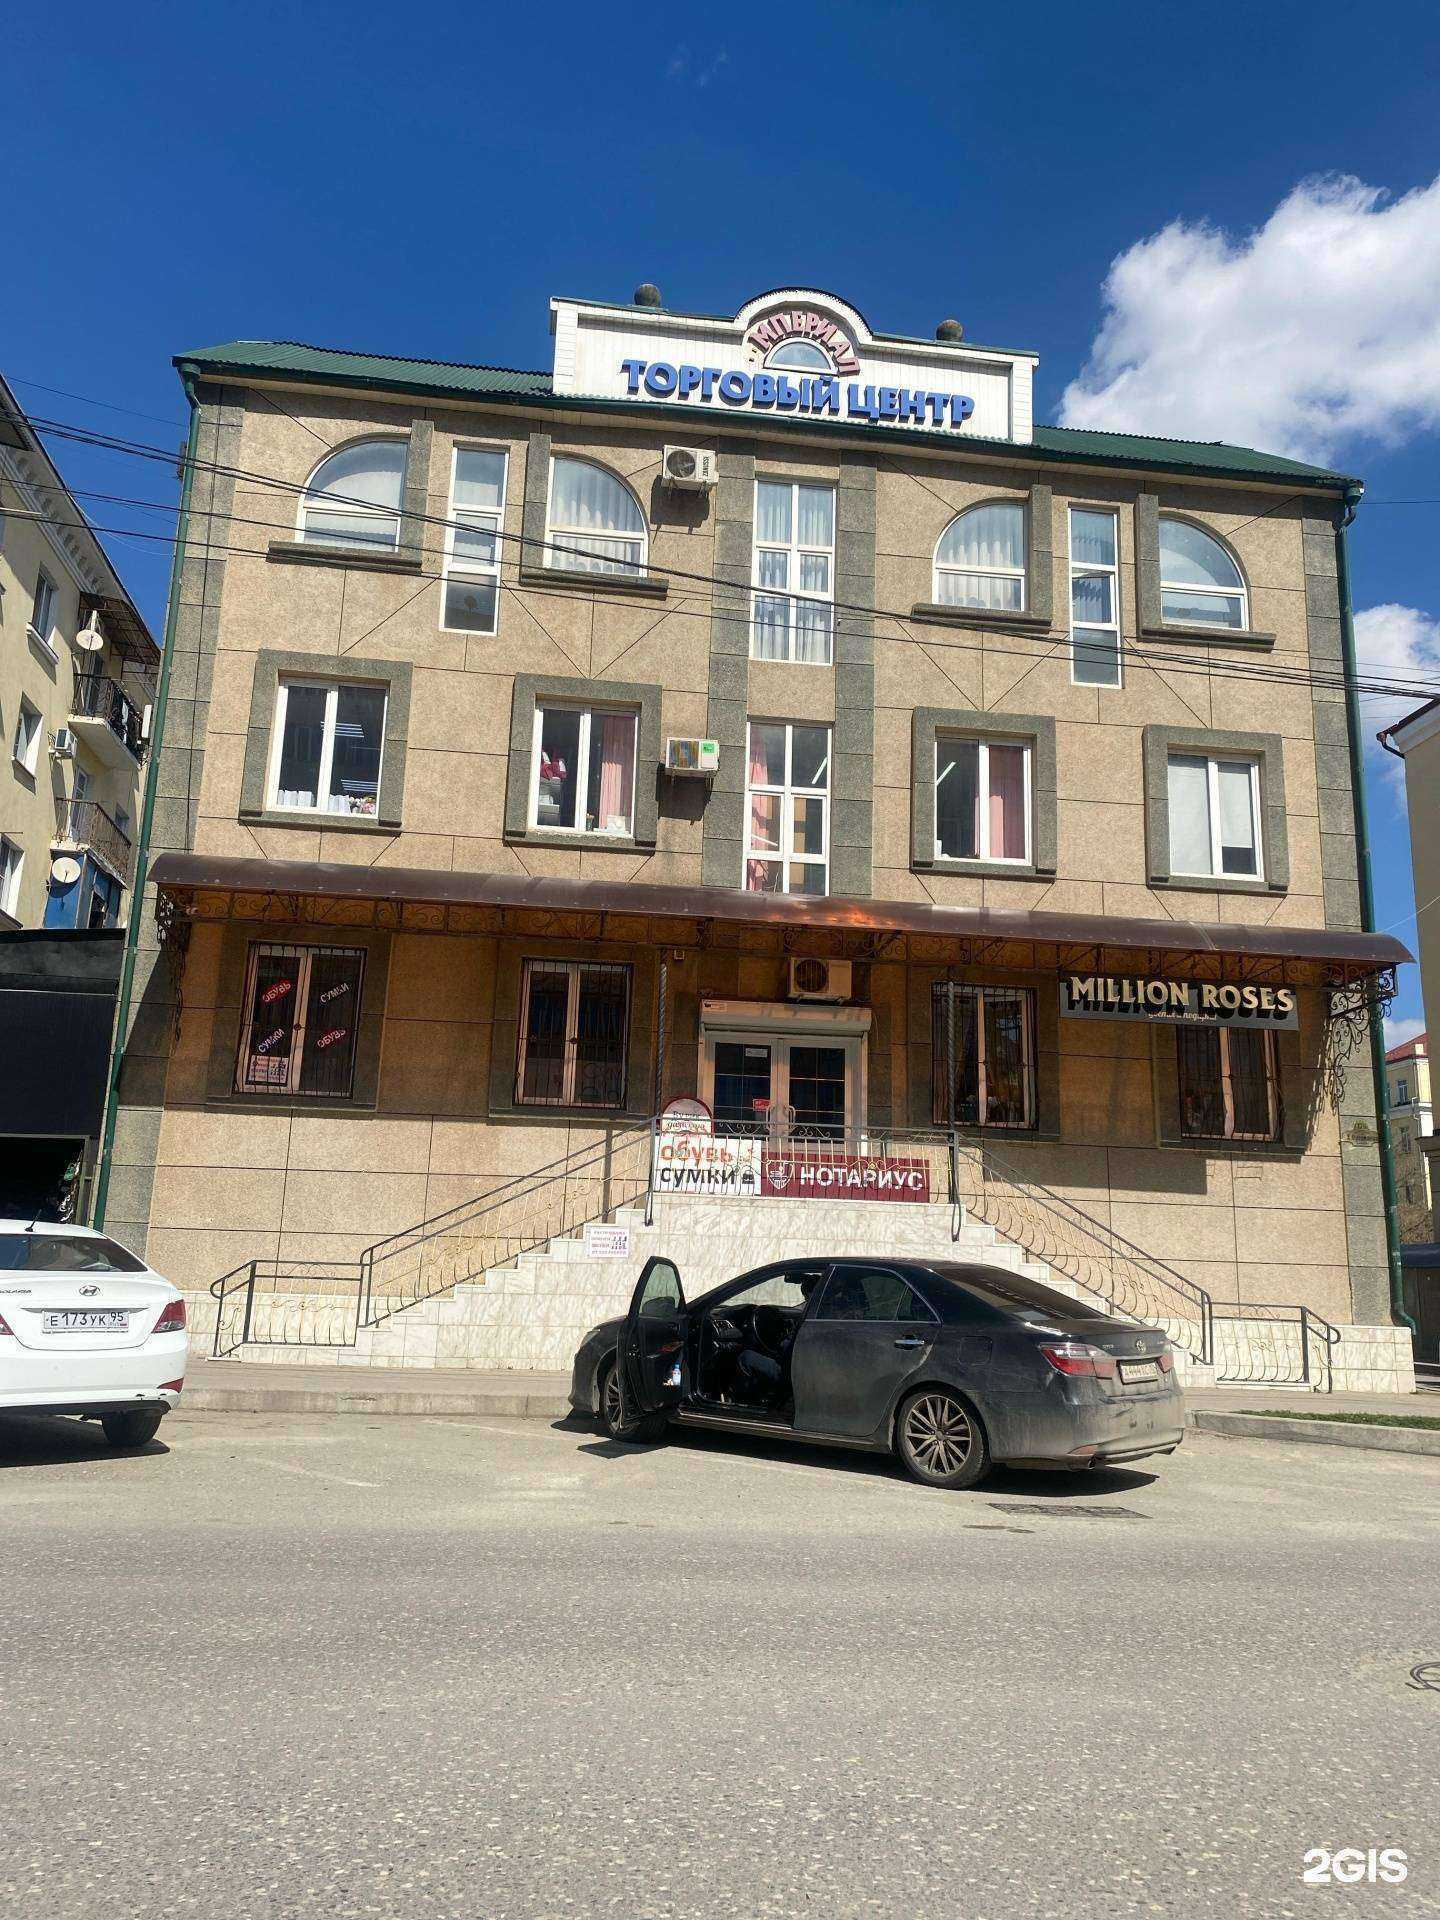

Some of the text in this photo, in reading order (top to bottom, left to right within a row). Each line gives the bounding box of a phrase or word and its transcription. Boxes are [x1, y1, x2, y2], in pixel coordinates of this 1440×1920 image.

[621, 358, 975, 427] ТОРГОВЫЙ ЦЕНТР
[262, 981, 292, 1003] ОБУВЬ
[320, 982, 350, 1003] СУМКИ
[1070, 976, 1295, 1012] MILLION ROSES
[258, 1028, 286, 1053] СУМКИ
[799, 1166, 923, 1191] НОТАРИУС
